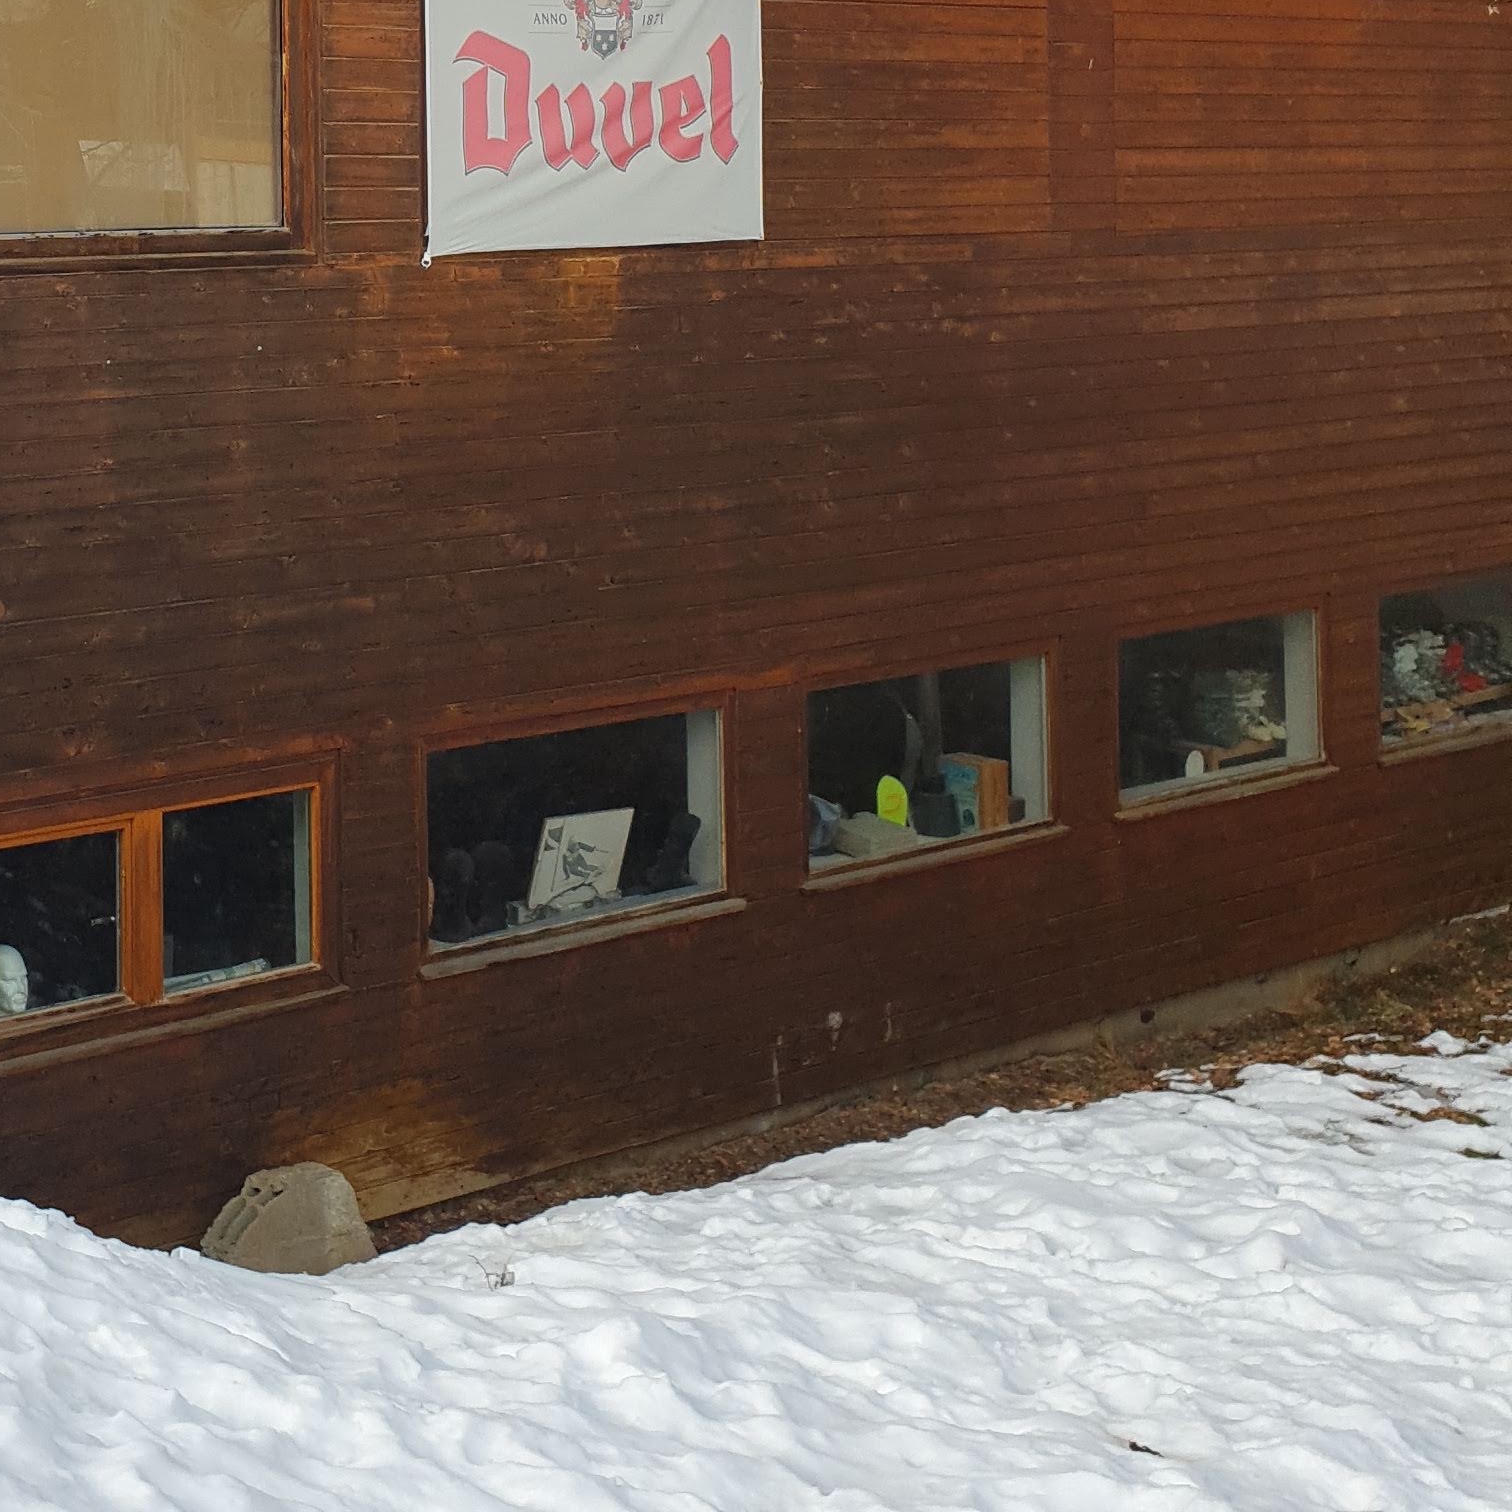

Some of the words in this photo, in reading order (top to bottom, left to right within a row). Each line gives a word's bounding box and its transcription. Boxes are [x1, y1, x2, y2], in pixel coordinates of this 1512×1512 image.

[533, 12, 568, 26] ANNO
[641, 13, 665, 26] 1871
[452, 30, 739, 176] Duvel
